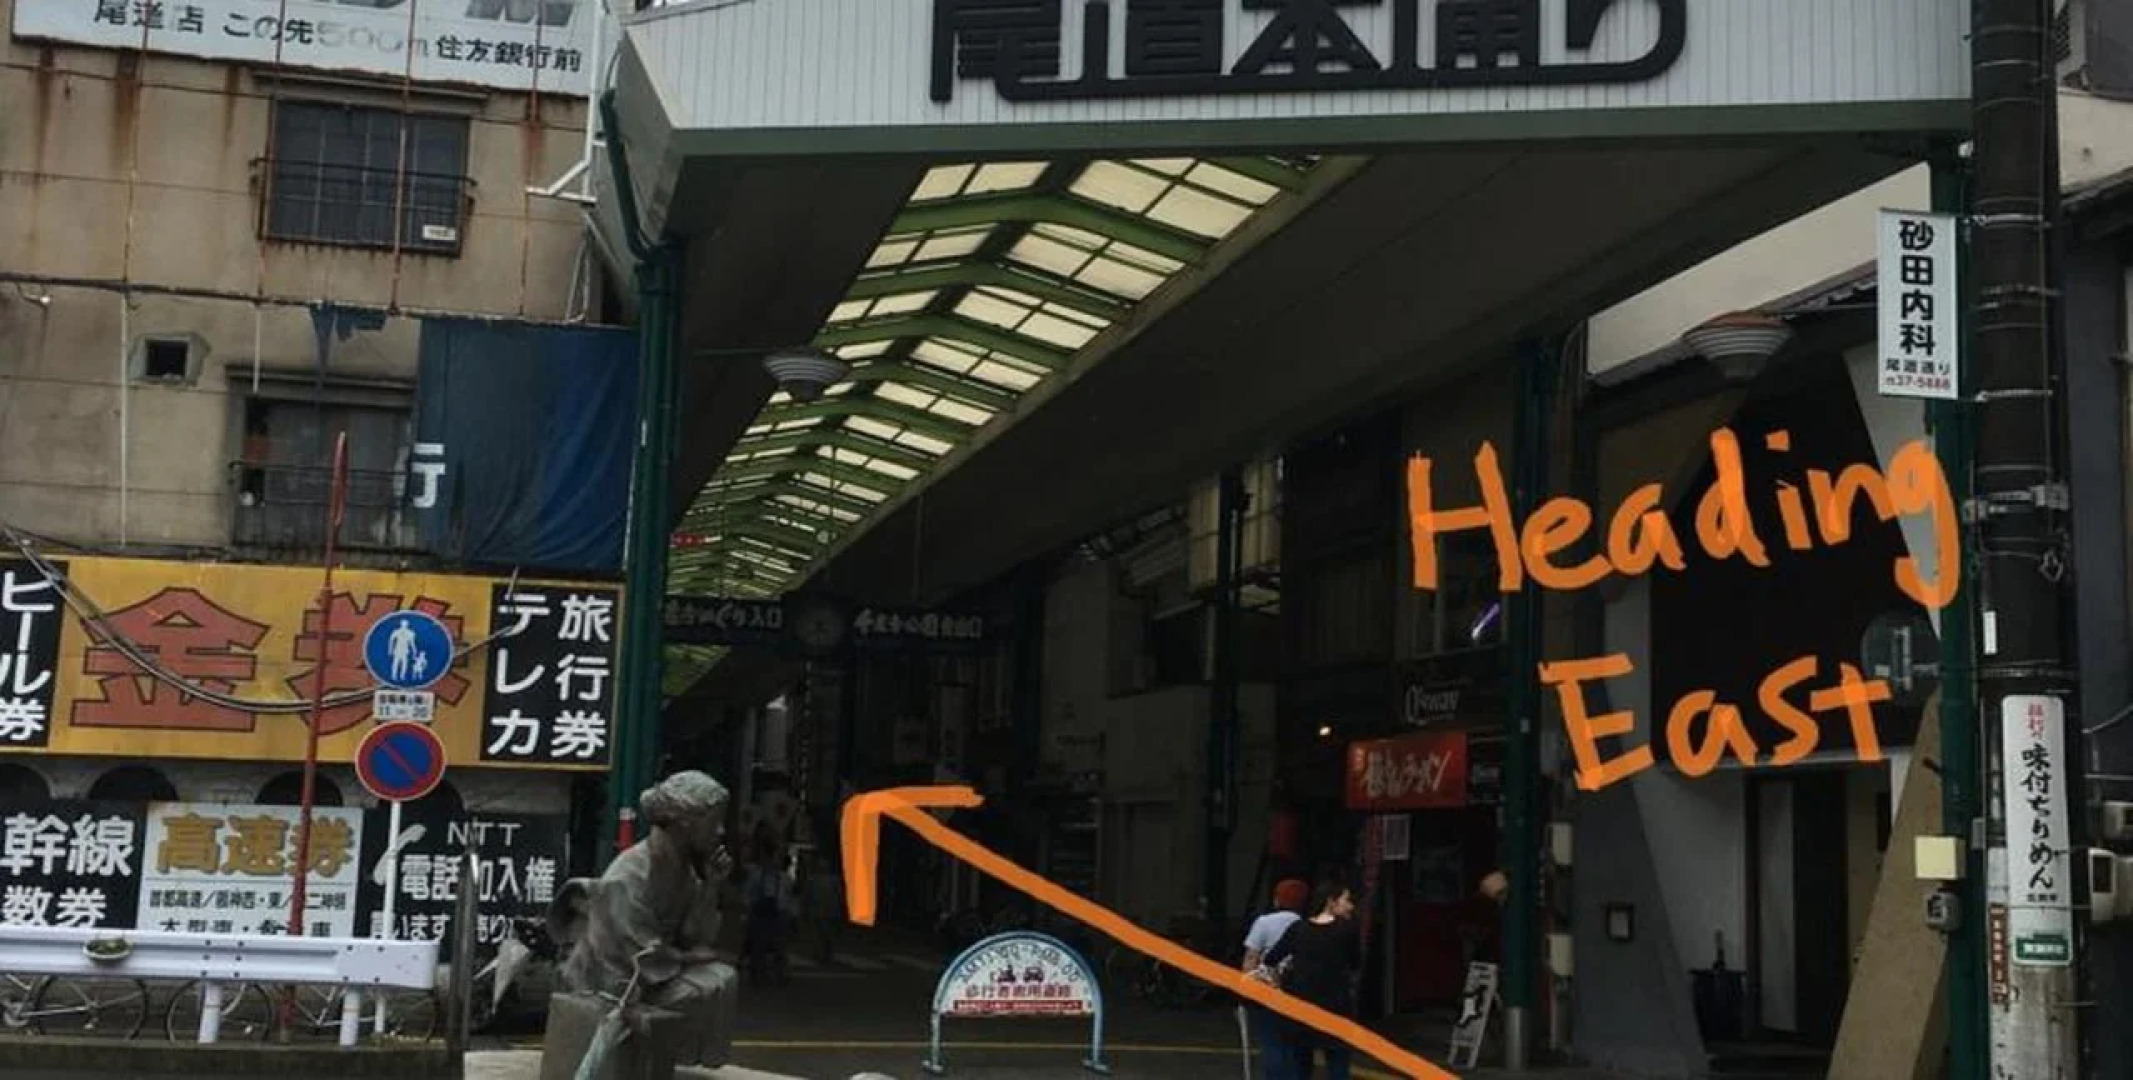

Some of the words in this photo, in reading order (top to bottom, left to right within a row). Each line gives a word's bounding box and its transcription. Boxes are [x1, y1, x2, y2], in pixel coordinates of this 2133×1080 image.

[931, 0, 1685, 102] 尾道本通り
[1899, 219, 1936, 356] 砂田内科
[487, 590, 550, 757] テレカ
[551, 594, 614, 760] 旅行券
[157, 812, 356, 881] 高速券
[446, 820, 522, 847] NTT
[2019, 743, 2054, 890] 味付ちりめん
